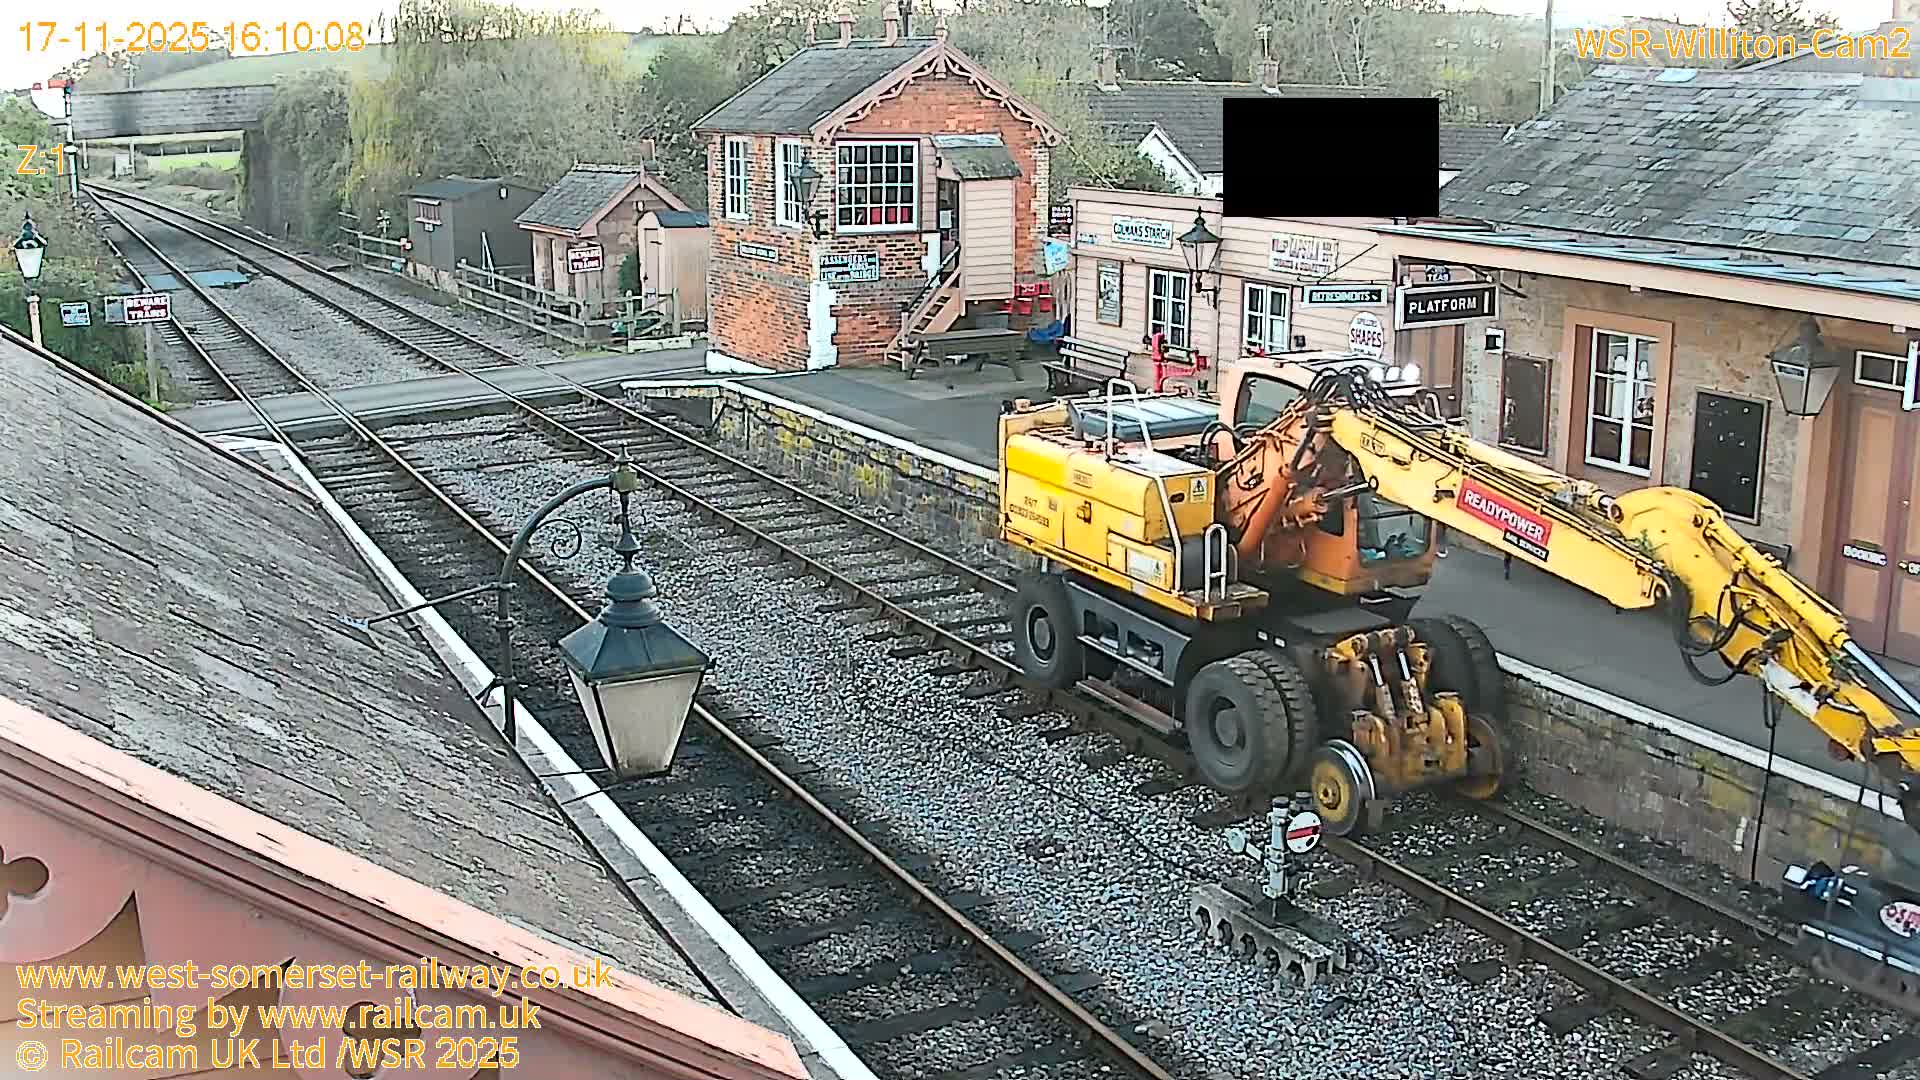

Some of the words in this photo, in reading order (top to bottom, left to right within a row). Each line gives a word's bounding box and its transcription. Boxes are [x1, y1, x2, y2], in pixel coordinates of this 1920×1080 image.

[1408, 297, 1477, 315] PLATFORM
[1483, 291, 1490, 314] 1
[1350, 327, 1382, 348] SHAPES
[1464, 489, 1545, 541] READYPOWER
[1843, 545, 1887, 566] BOOKING
